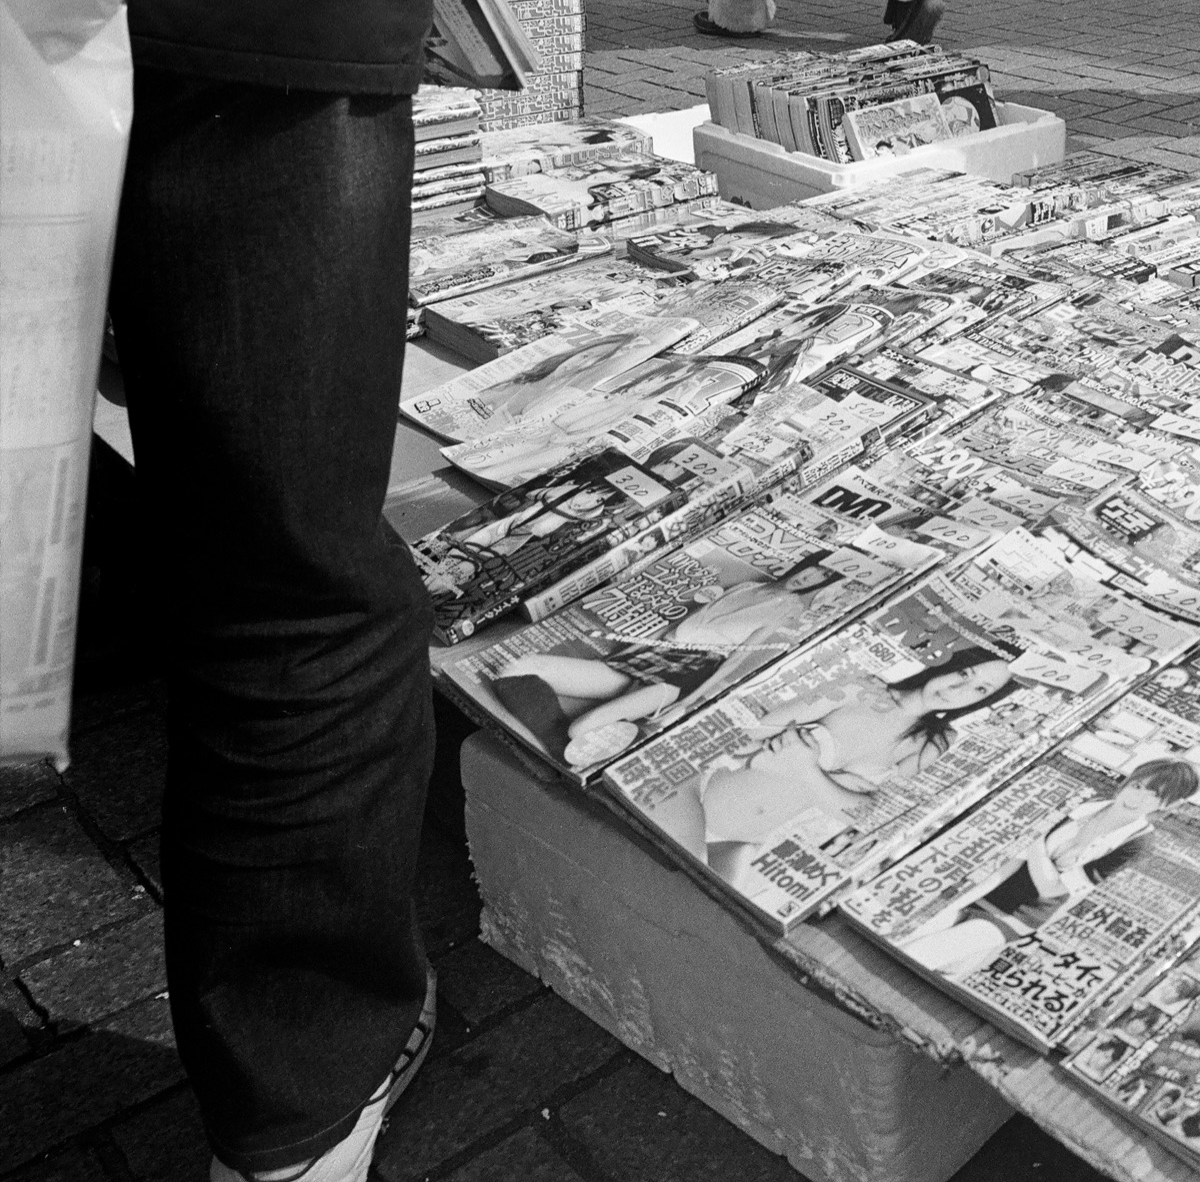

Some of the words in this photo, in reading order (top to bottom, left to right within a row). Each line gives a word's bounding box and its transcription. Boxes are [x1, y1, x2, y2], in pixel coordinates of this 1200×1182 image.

[614, 475, 648, 498] 300
[868, 537, 896, 550] 100
[931, 525, 970, 542] 100
[830, 558, 872, 578] 100
[1108, 615, 1159, 642] 200
[1024, 664, 1070, 682] 100
[750, 851, 819, 902] Hitomi
